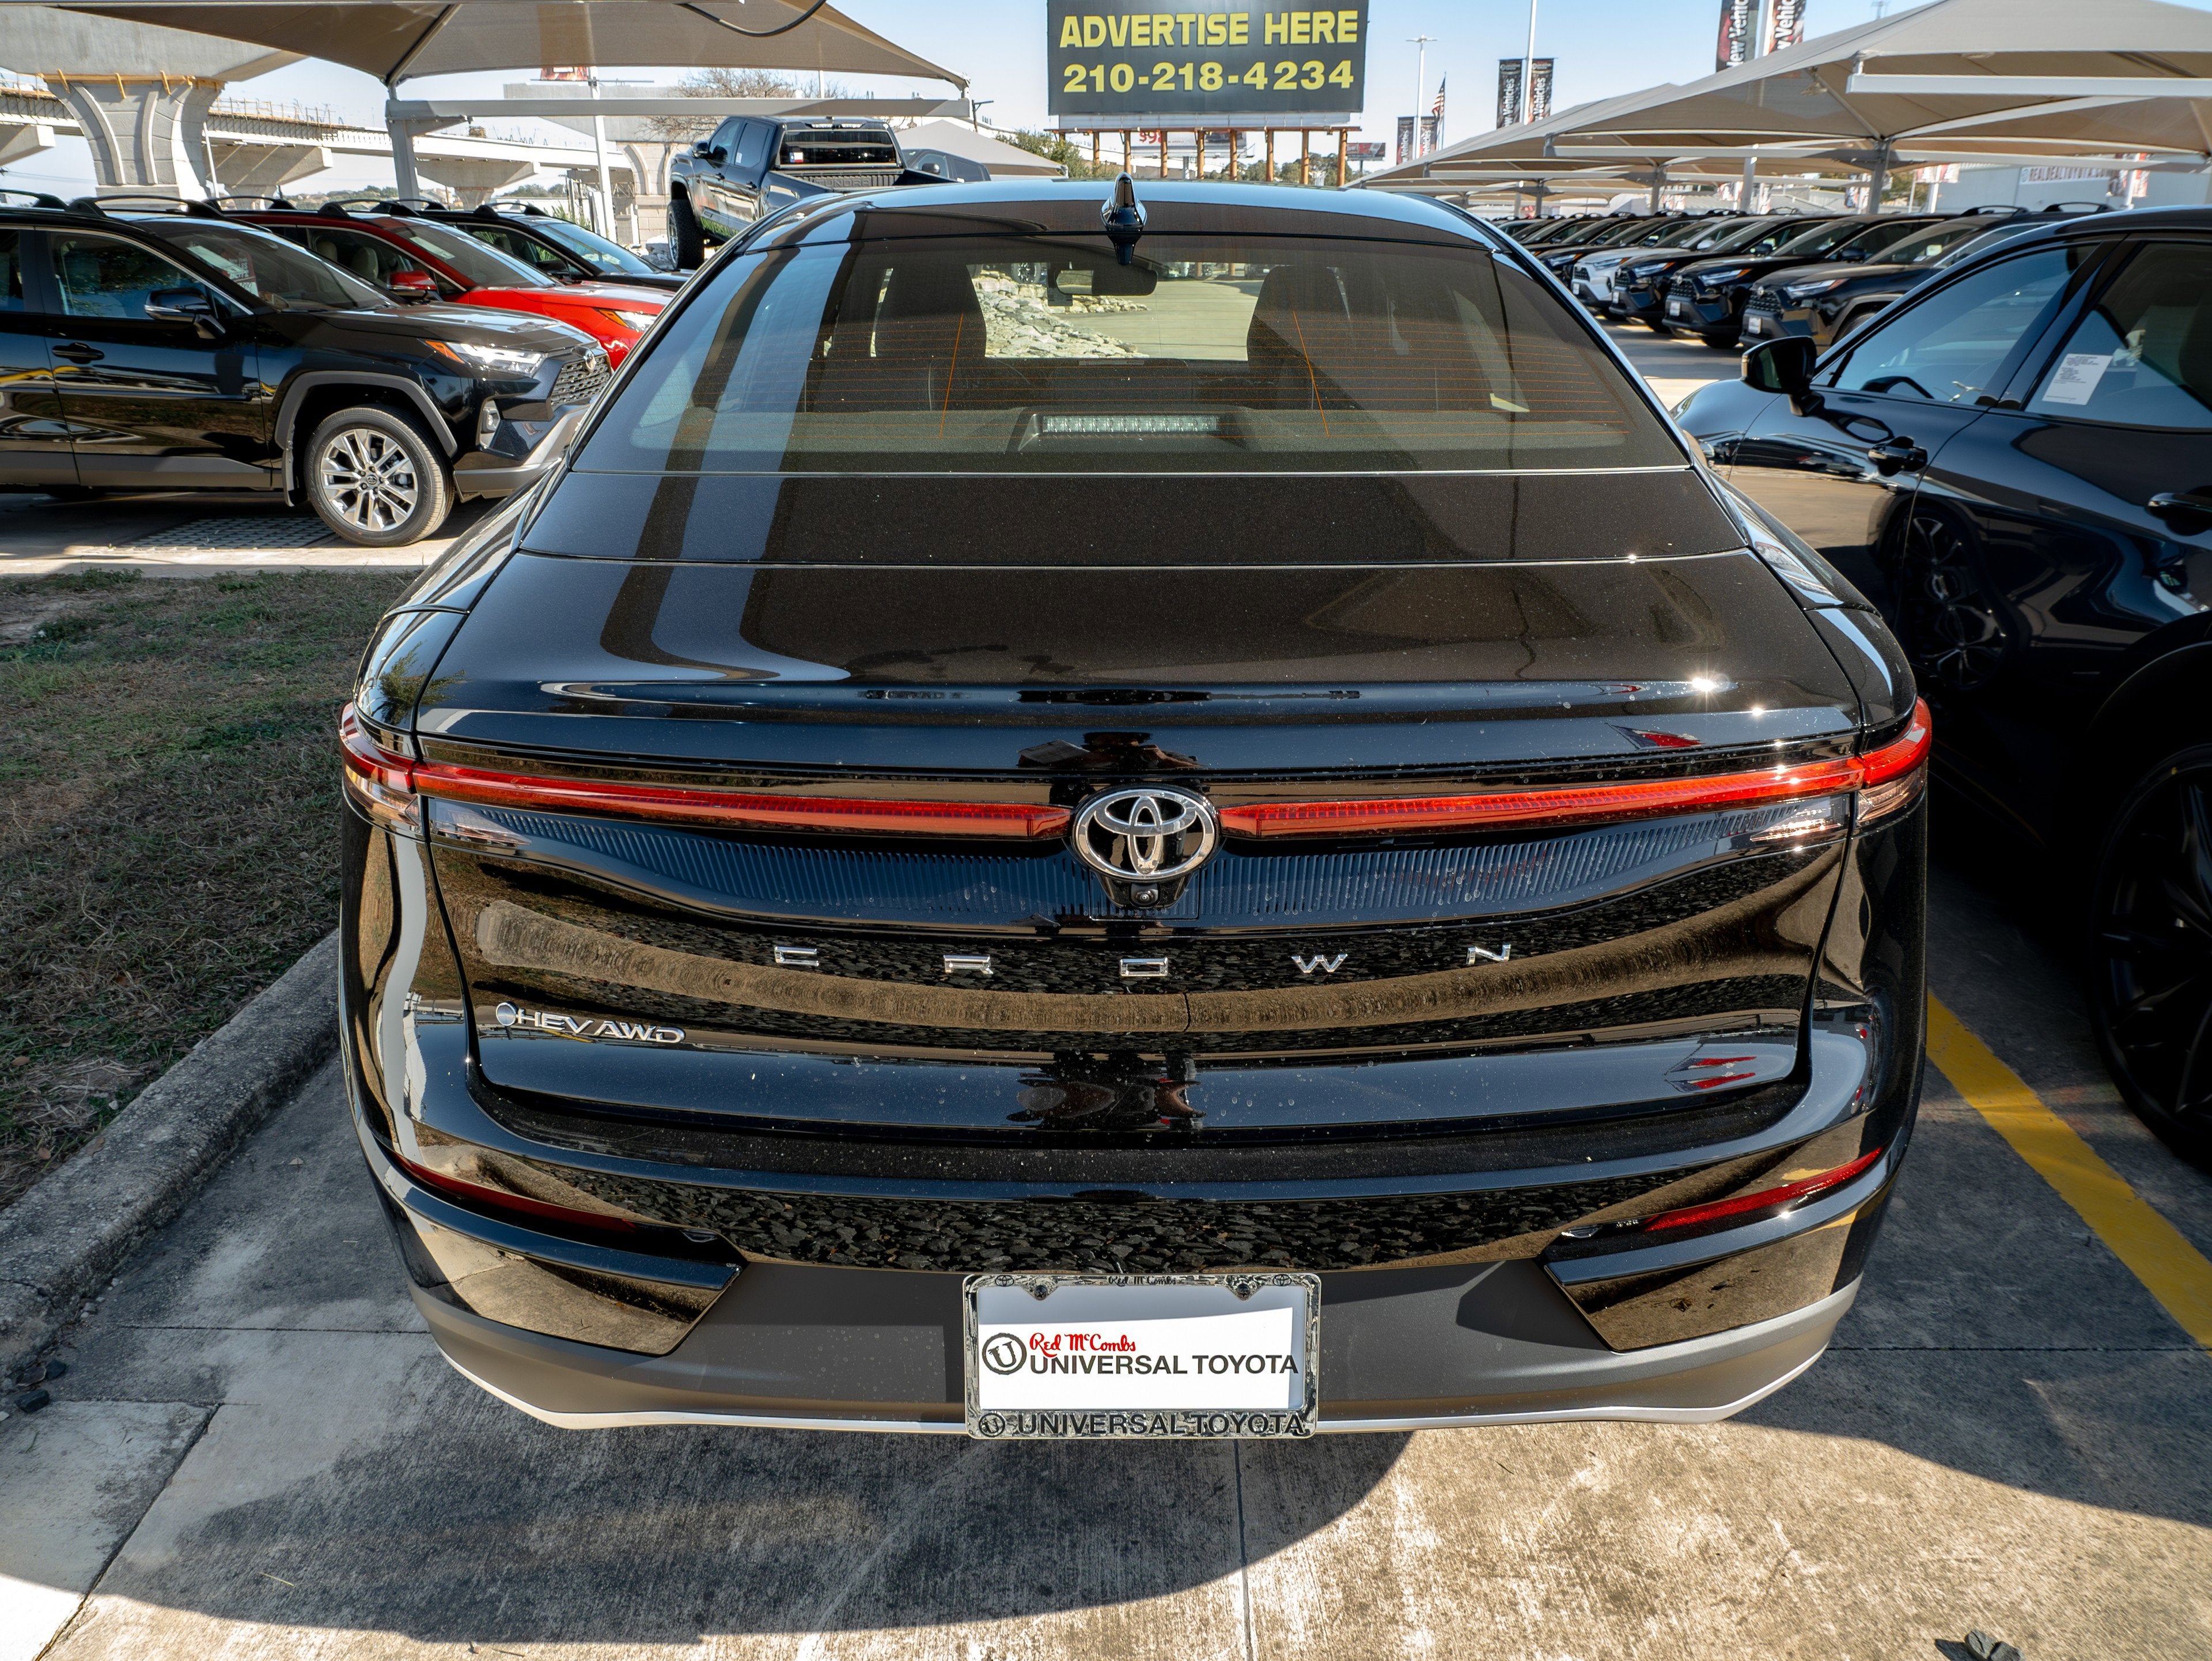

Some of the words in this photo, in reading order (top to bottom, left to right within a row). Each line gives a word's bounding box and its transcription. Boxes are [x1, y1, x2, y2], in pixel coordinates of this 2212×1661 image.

[1059, 13, 1249, 48] ADVERTISE
[1265, 10, 1358, 45] HERE
[1063, 60, 1354, 93] 210-218-4234
[1502, 78, 1515, 116] Vehicles
[1533, 77, 1546, 115] Vehicles
[517, 1008, 594, 1034] HEV
[594, 1020, 686, 1043] AWD
[1029, 1332, 1061, 1358] Red
[1065, 1333, 1136, 1352] McCombs
[1030, 1354, 1188, 1375] UNIVERSAL
[1192, 1354, 1298, 1374] TOYOTA
[1017, 1413, 1186, 1435] UNIVERSAL
[1190, 1413, 1305, 1435] TOYOTA
